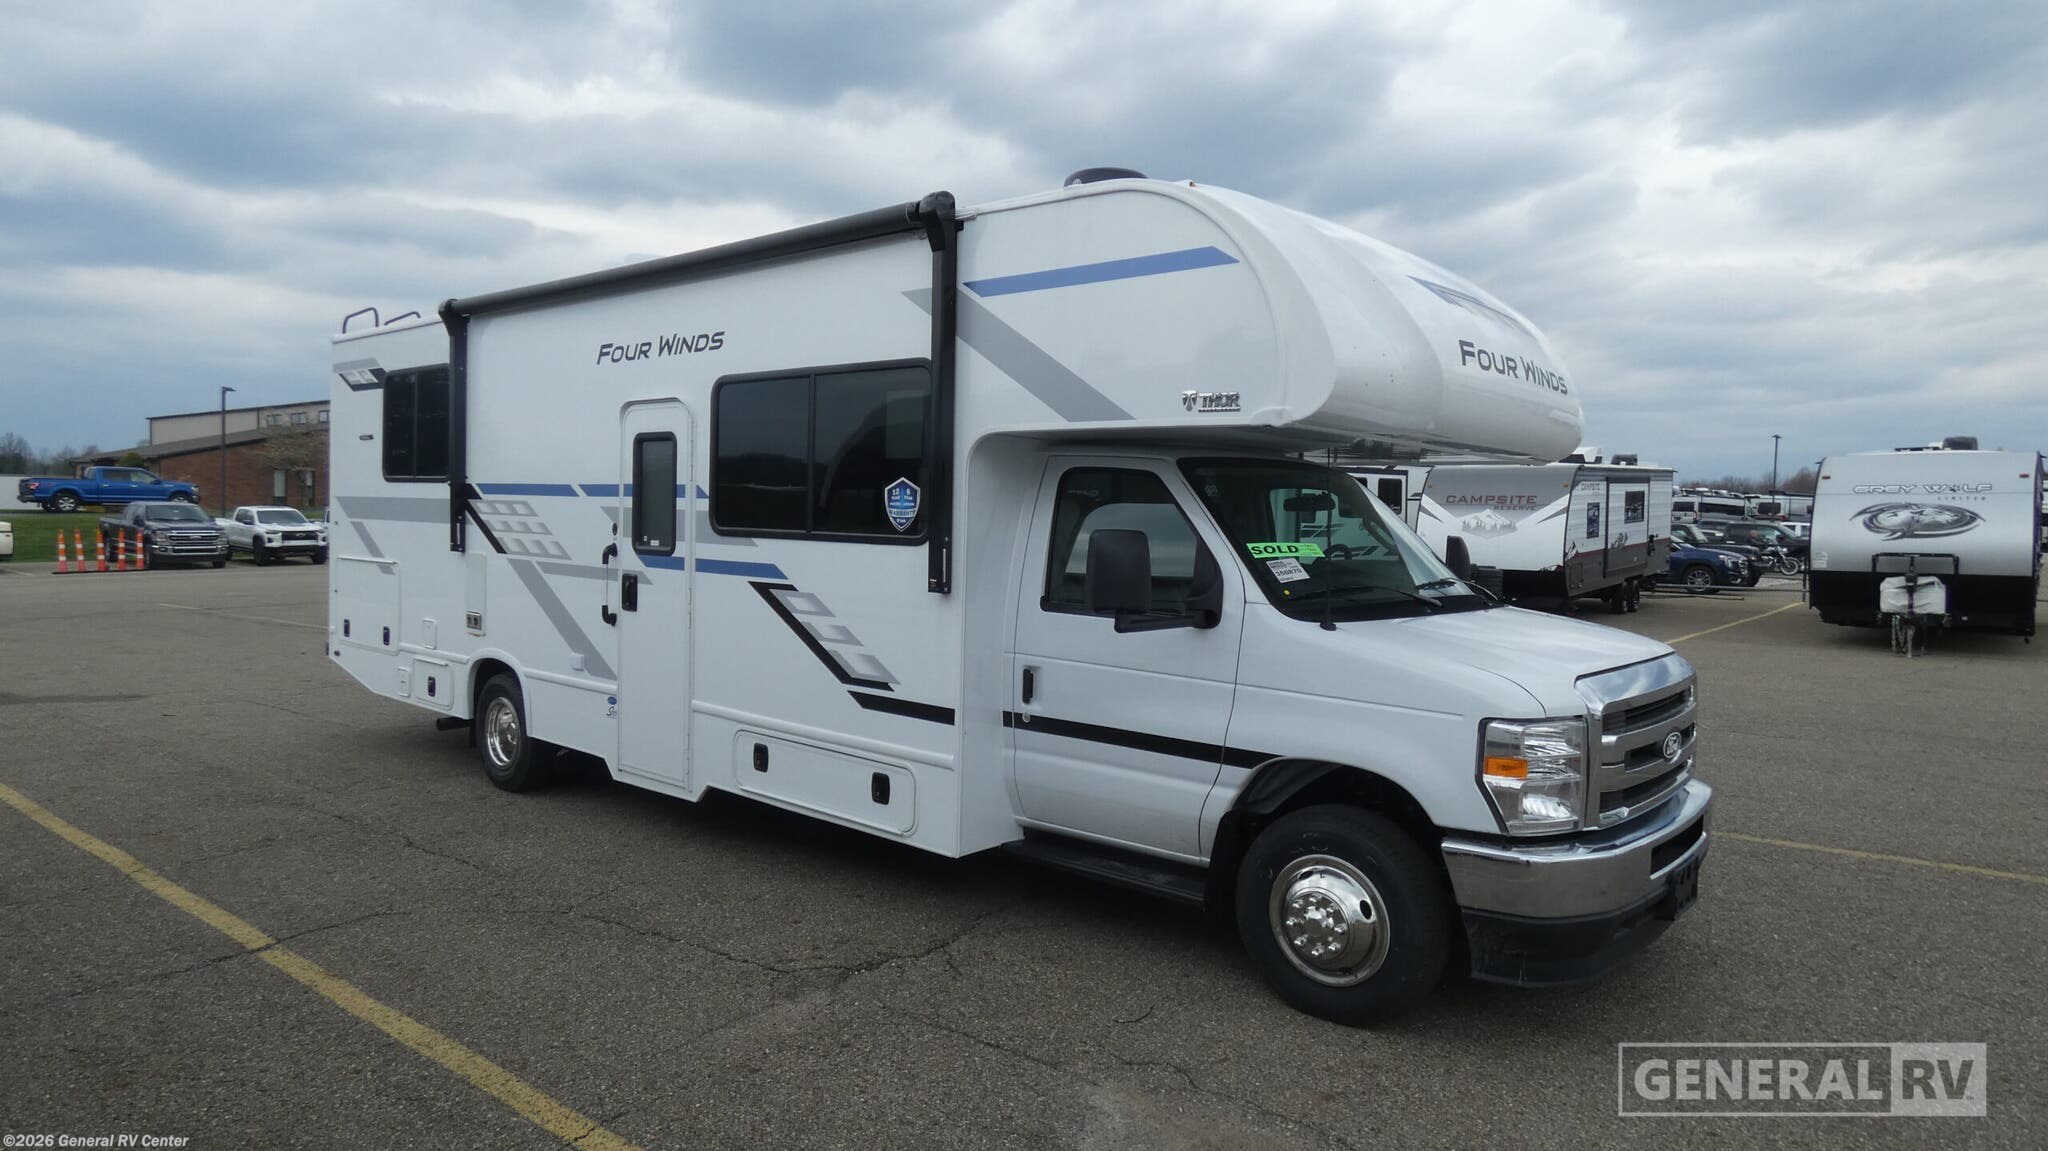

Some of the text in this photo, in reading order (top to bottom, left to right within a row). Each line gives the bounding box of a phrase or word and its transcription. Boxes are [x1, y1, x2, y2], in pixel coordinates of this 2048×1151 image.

[597, 331, 725, 365] FOUR WINDS
[1459, 340, 1568, 395] FOUR WINDS
[1199, 392, 1240, 408] THOR
[1853, 484, 1916, 494] GREY
[1445, 495, 1537, 505] CAMPSITE
[1251, 545, 1299, 555] SOLD
